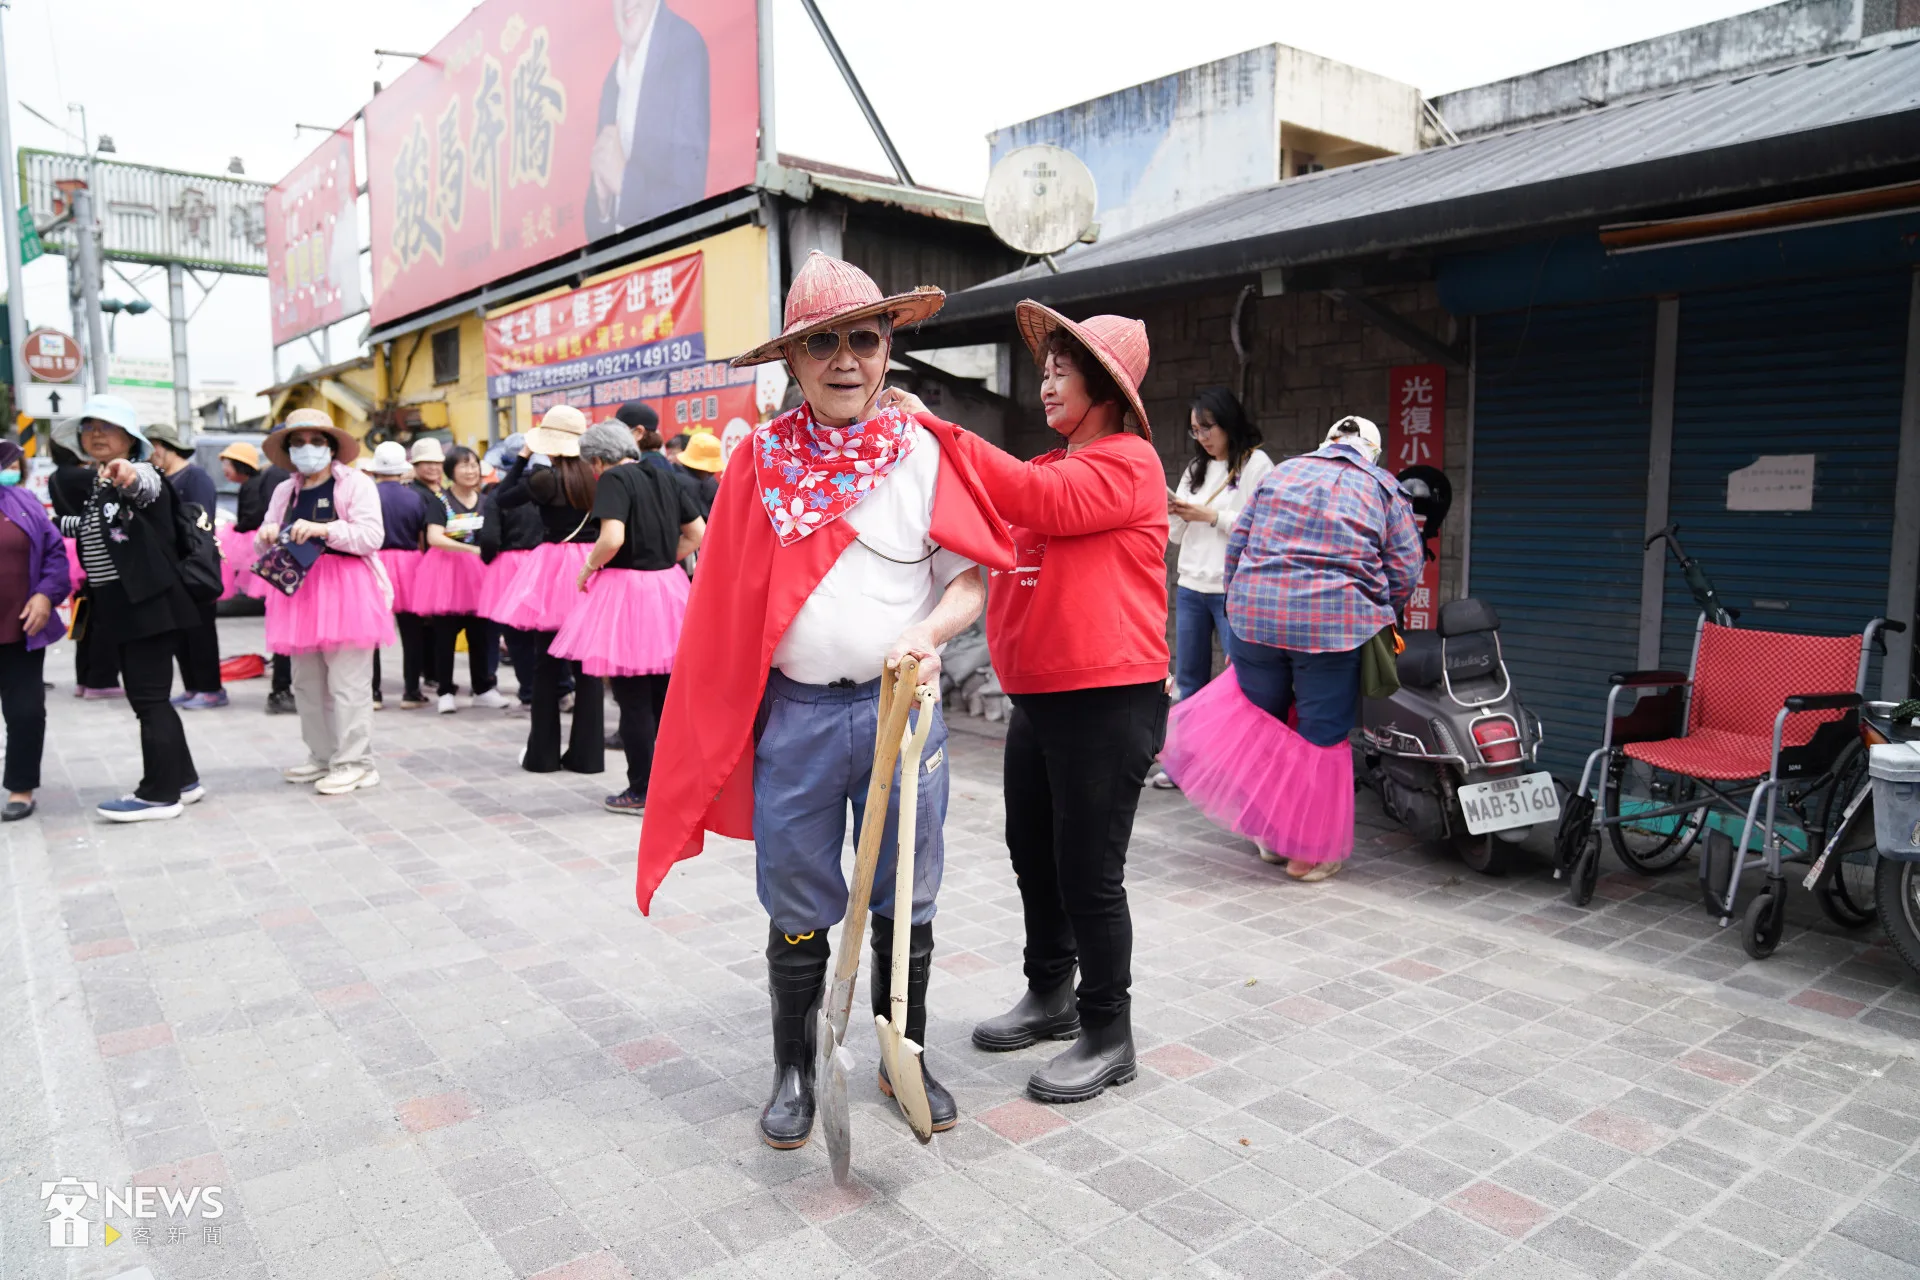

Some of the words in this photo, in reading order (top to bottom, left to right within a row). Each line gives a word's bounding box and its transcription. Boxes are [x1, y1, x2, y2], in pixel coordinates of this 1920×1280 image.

[626, 266, 675, 313] 出租
[1400, 375, 1433, 472] 光復小
